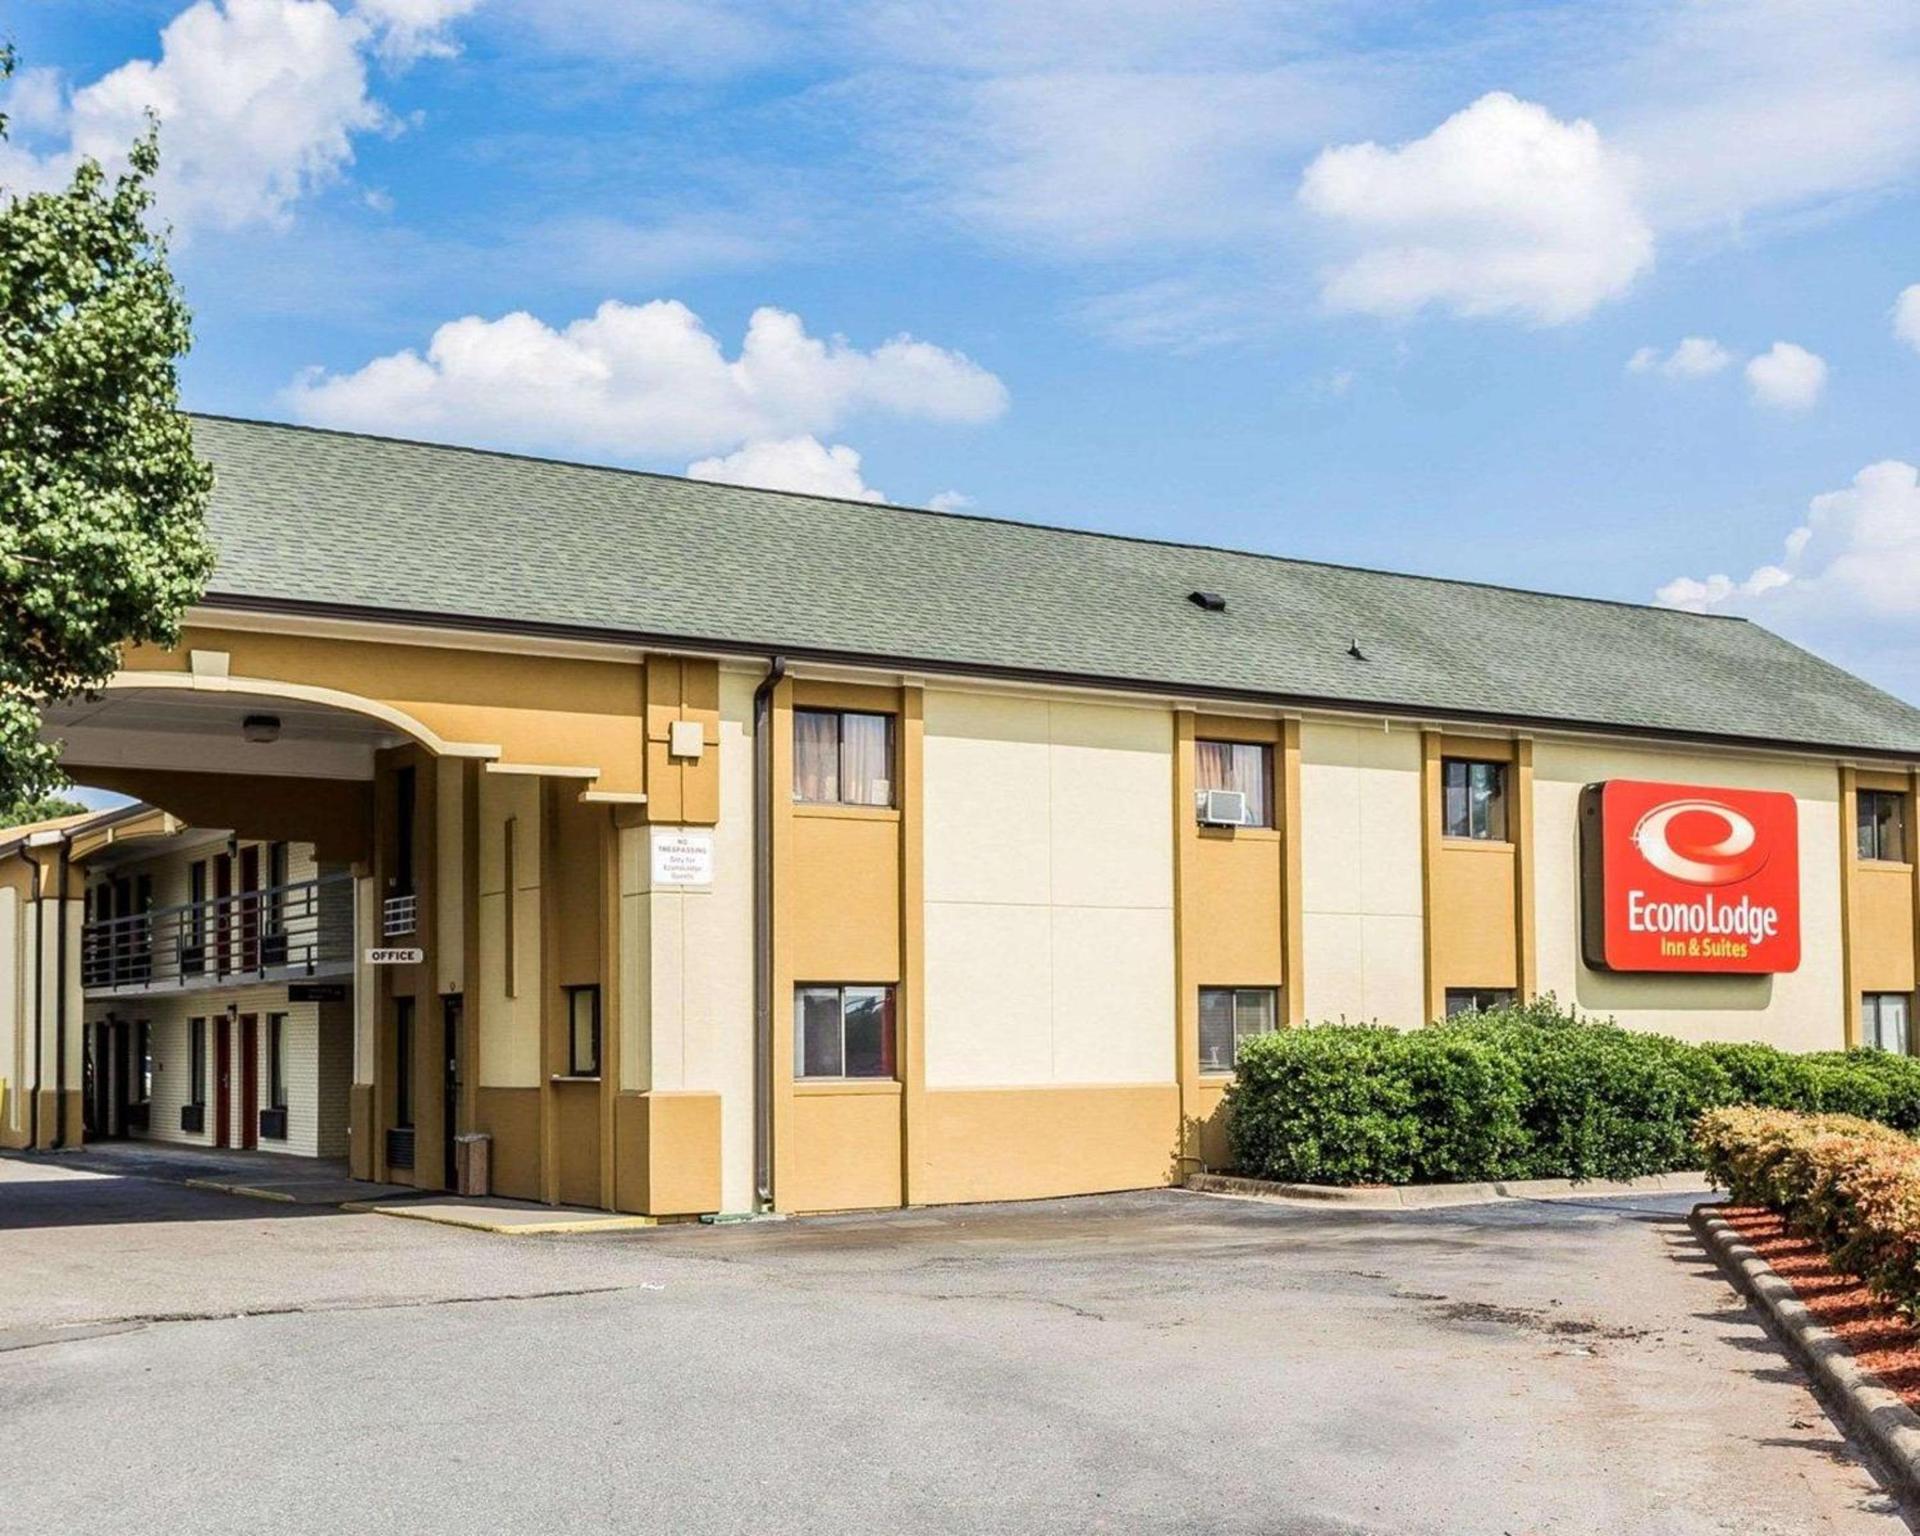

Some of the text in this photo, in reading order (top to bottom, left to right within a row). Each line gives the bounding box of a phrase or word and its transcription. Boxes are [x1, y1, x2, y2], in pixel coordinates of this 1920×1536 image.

[1628, 890, 1778, 945] EconoLodge
[371, 951, 415, 961] OFFICE
[1661, 936, 1749, 959] Inn & Suites
